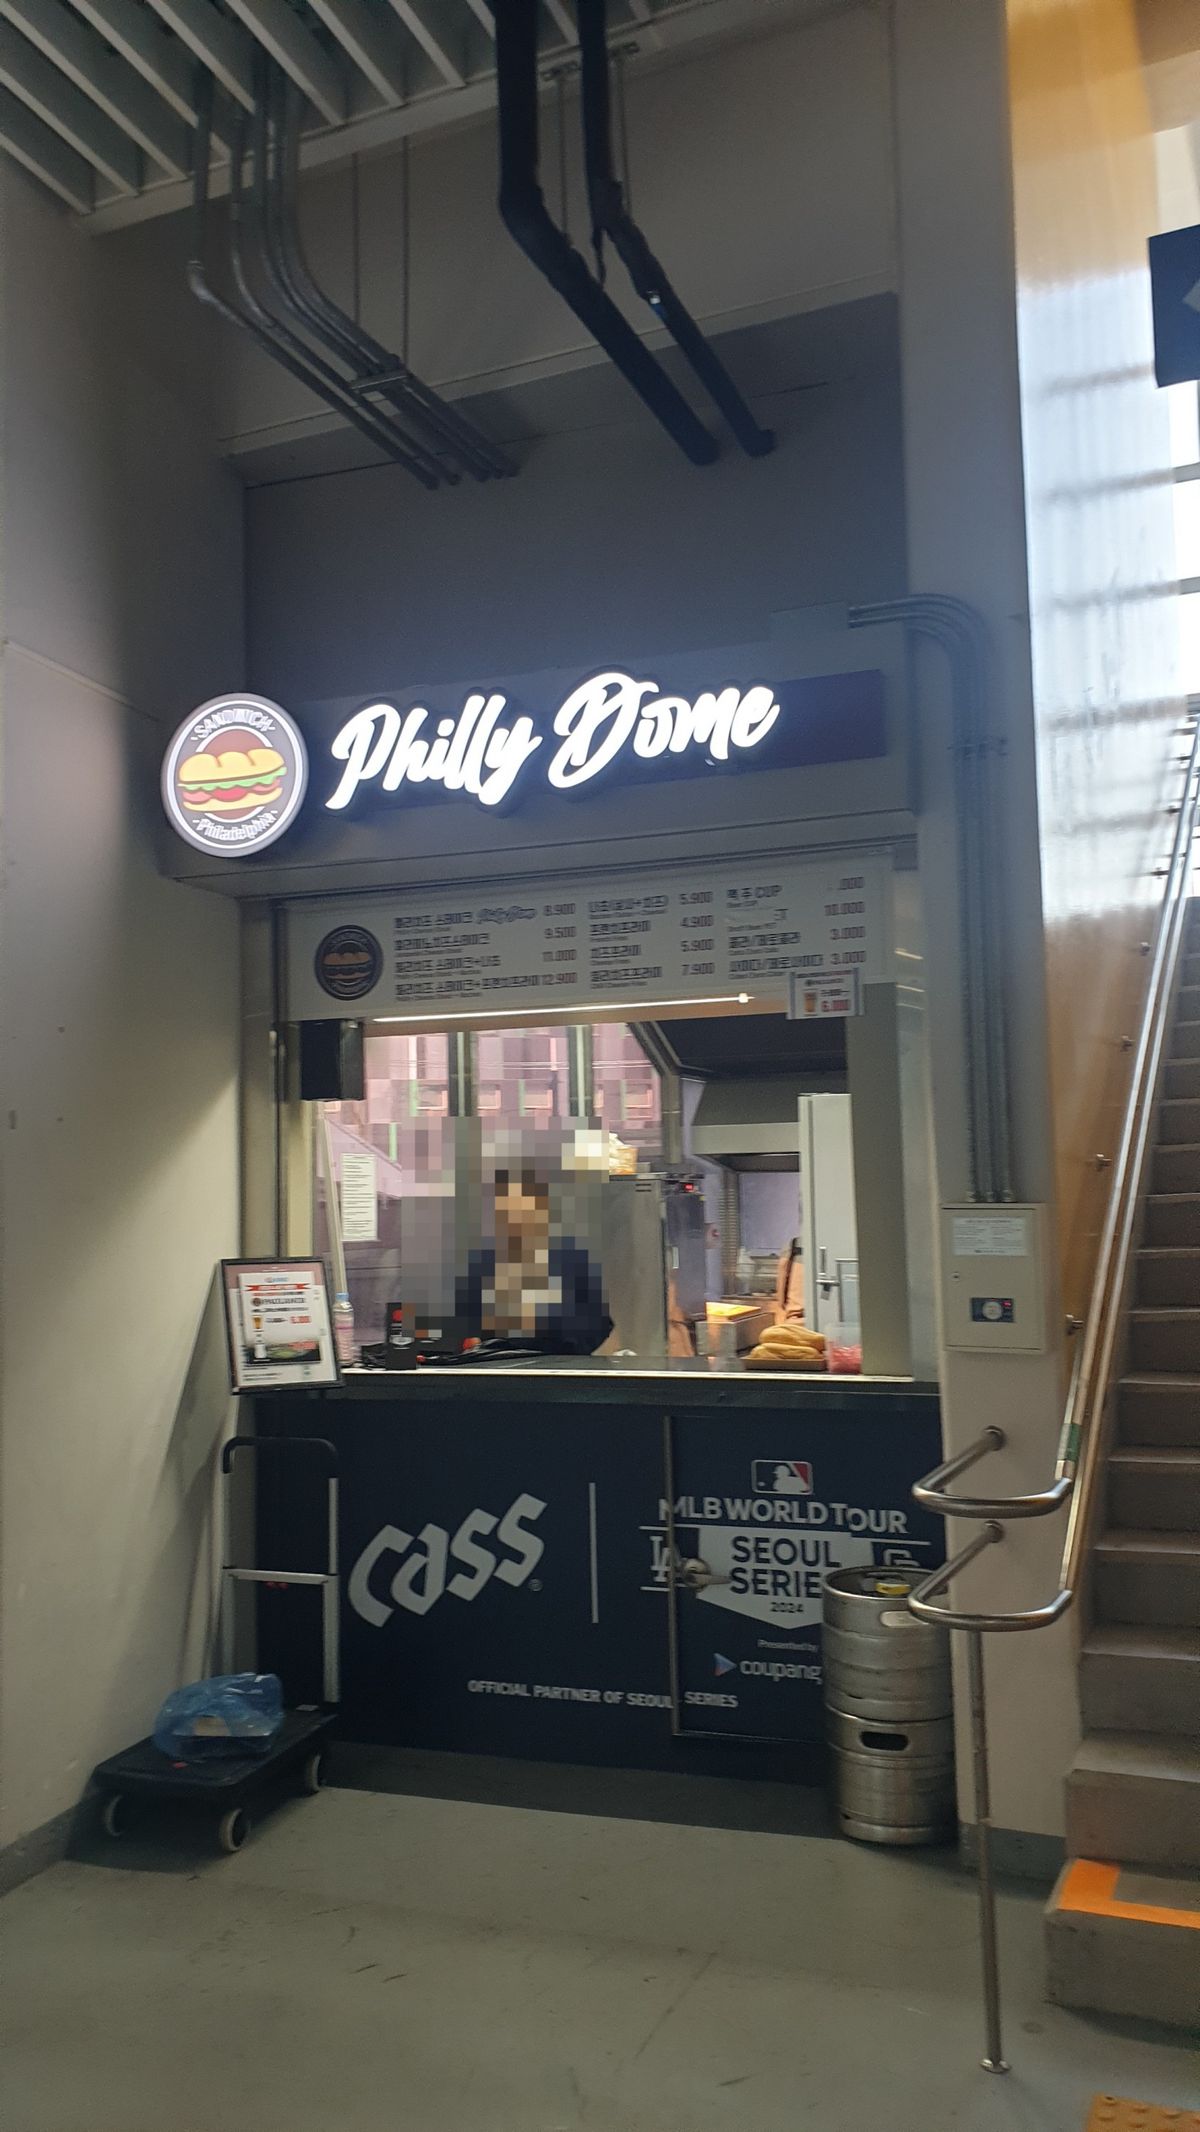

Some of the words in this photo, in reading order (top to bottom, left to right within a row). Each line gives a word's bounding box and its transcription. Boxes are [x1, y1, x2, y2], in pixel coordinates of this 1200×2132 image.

[325, 694, 542, 809] Philly
[547, 672, 780, 789] Dome
[658, 1496, 723, 1520] MLB
[725, 1498, 829, 1525] WORLD
[829, 1503, 908, 1534] TOUR
[731, 1536, 842, 1568] SEOUL
[730, 1567, 824, 1599] SERIE
[770, 1601, 804, 1614] 2024
[740, 1660, 823, 1686] coupang
[467, 1680, 532, 1697] OFFICIAL
[533, 1685, 601, 1703] PARTNER
[603, 1690, 625, 1704] OF
[626, 1693, 674, 1709] SEOUL
[684, 1691, 739, 1708] SERIES
